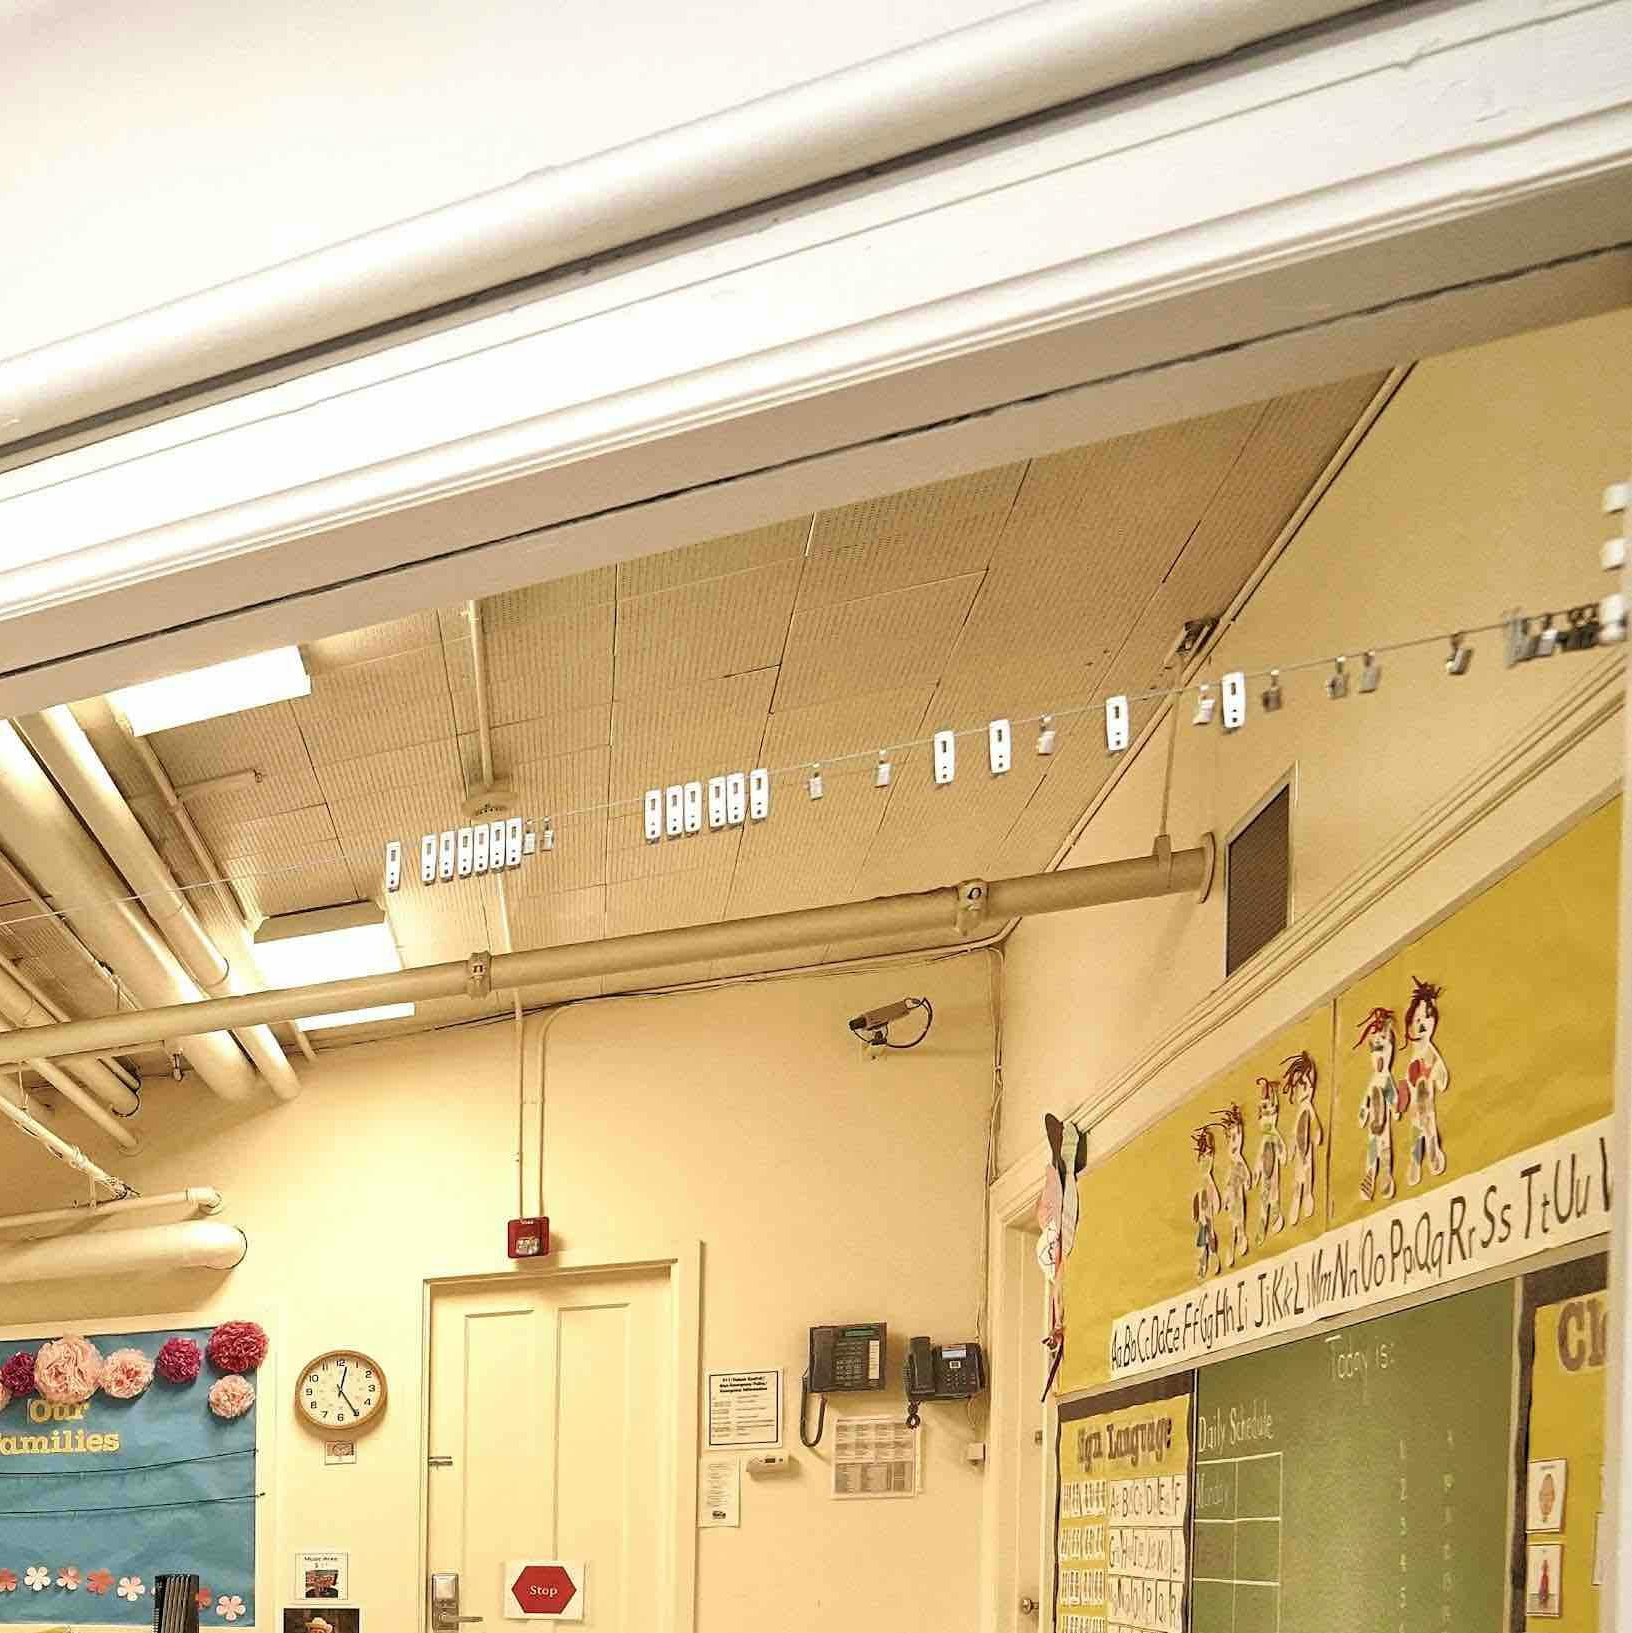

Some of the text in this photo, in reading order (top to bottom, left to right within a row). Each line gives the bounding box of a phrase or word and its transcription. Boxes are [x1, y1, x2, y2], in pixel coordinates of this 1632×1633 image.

[365, 1370, 372, 1379] 2
[305, 1388, 313, 1396] 9
[368, 1384, 375, 1392] 3
[310, 1401, 317, 1409] 8
[364, 1398, 371, 1406] 4
[30, 1399, 90, 1423] Our
[320, 1410, 328, 1418] 7
[337, 1413, 344, 1421] 6
[529, 1584, 558, 1598] Stop
